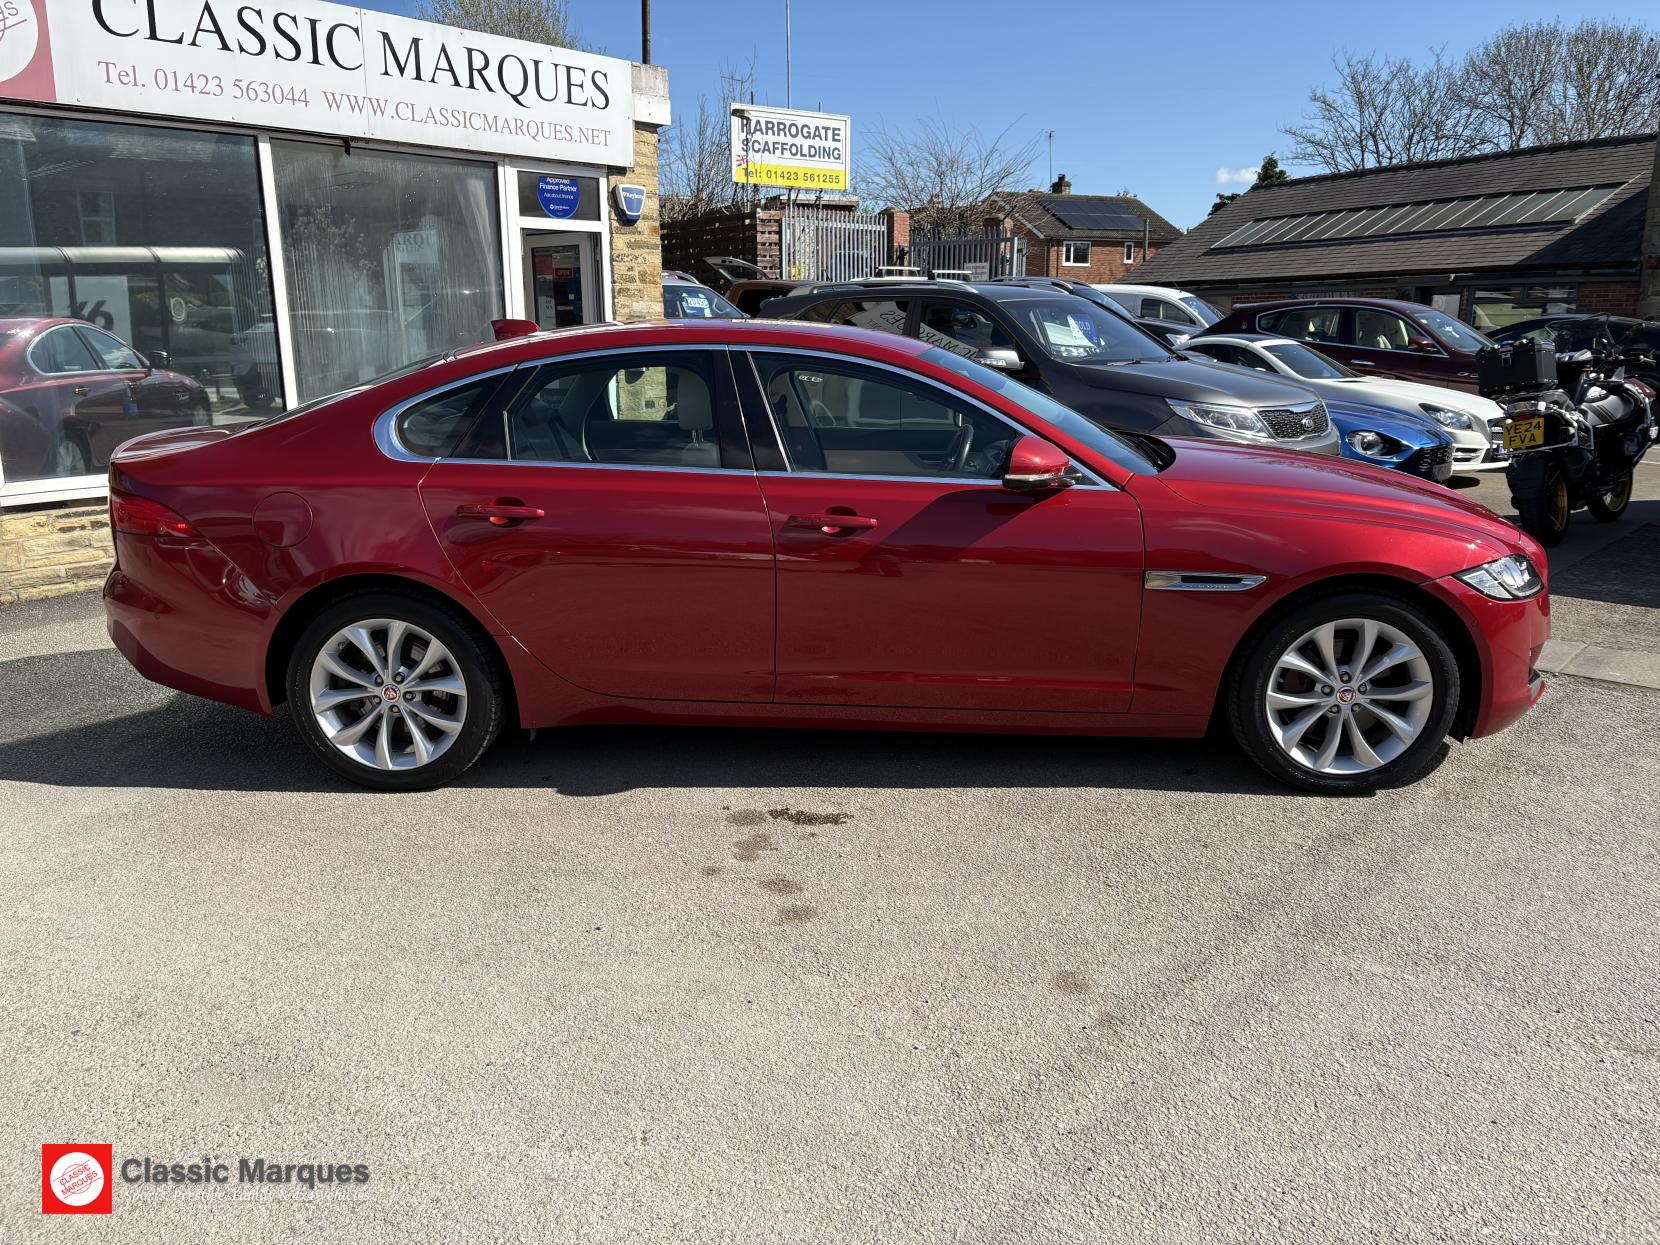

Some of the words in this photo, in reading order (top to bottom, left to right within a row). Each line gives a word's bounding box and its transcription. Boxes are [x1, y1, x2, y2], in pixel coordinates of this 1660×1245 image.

[91, 0, 363, 71] CLASSIC
[377, 30, 611, 110] MARQUES
[98, 61, 146, 88] Tel.
[154, 68, 225, 98] 01423
[232, 79, 310, 108] 563044
[322, 90, 611, 147] WWW.CLASSICMARQUES.NET
[741, 118, 842, 143] HARROGATE
[741, 138, 842, 161] SCAFFOLDING
[766, 169, 799, 181] 01423
[803, 172, 840, 184] 561255
[539, 182, 559, 191] Finance
[559, 184, 578, 192] Partner
[1505, 420, 1543, 436] YE24
[1508, 434, 1537, 446] FVA
